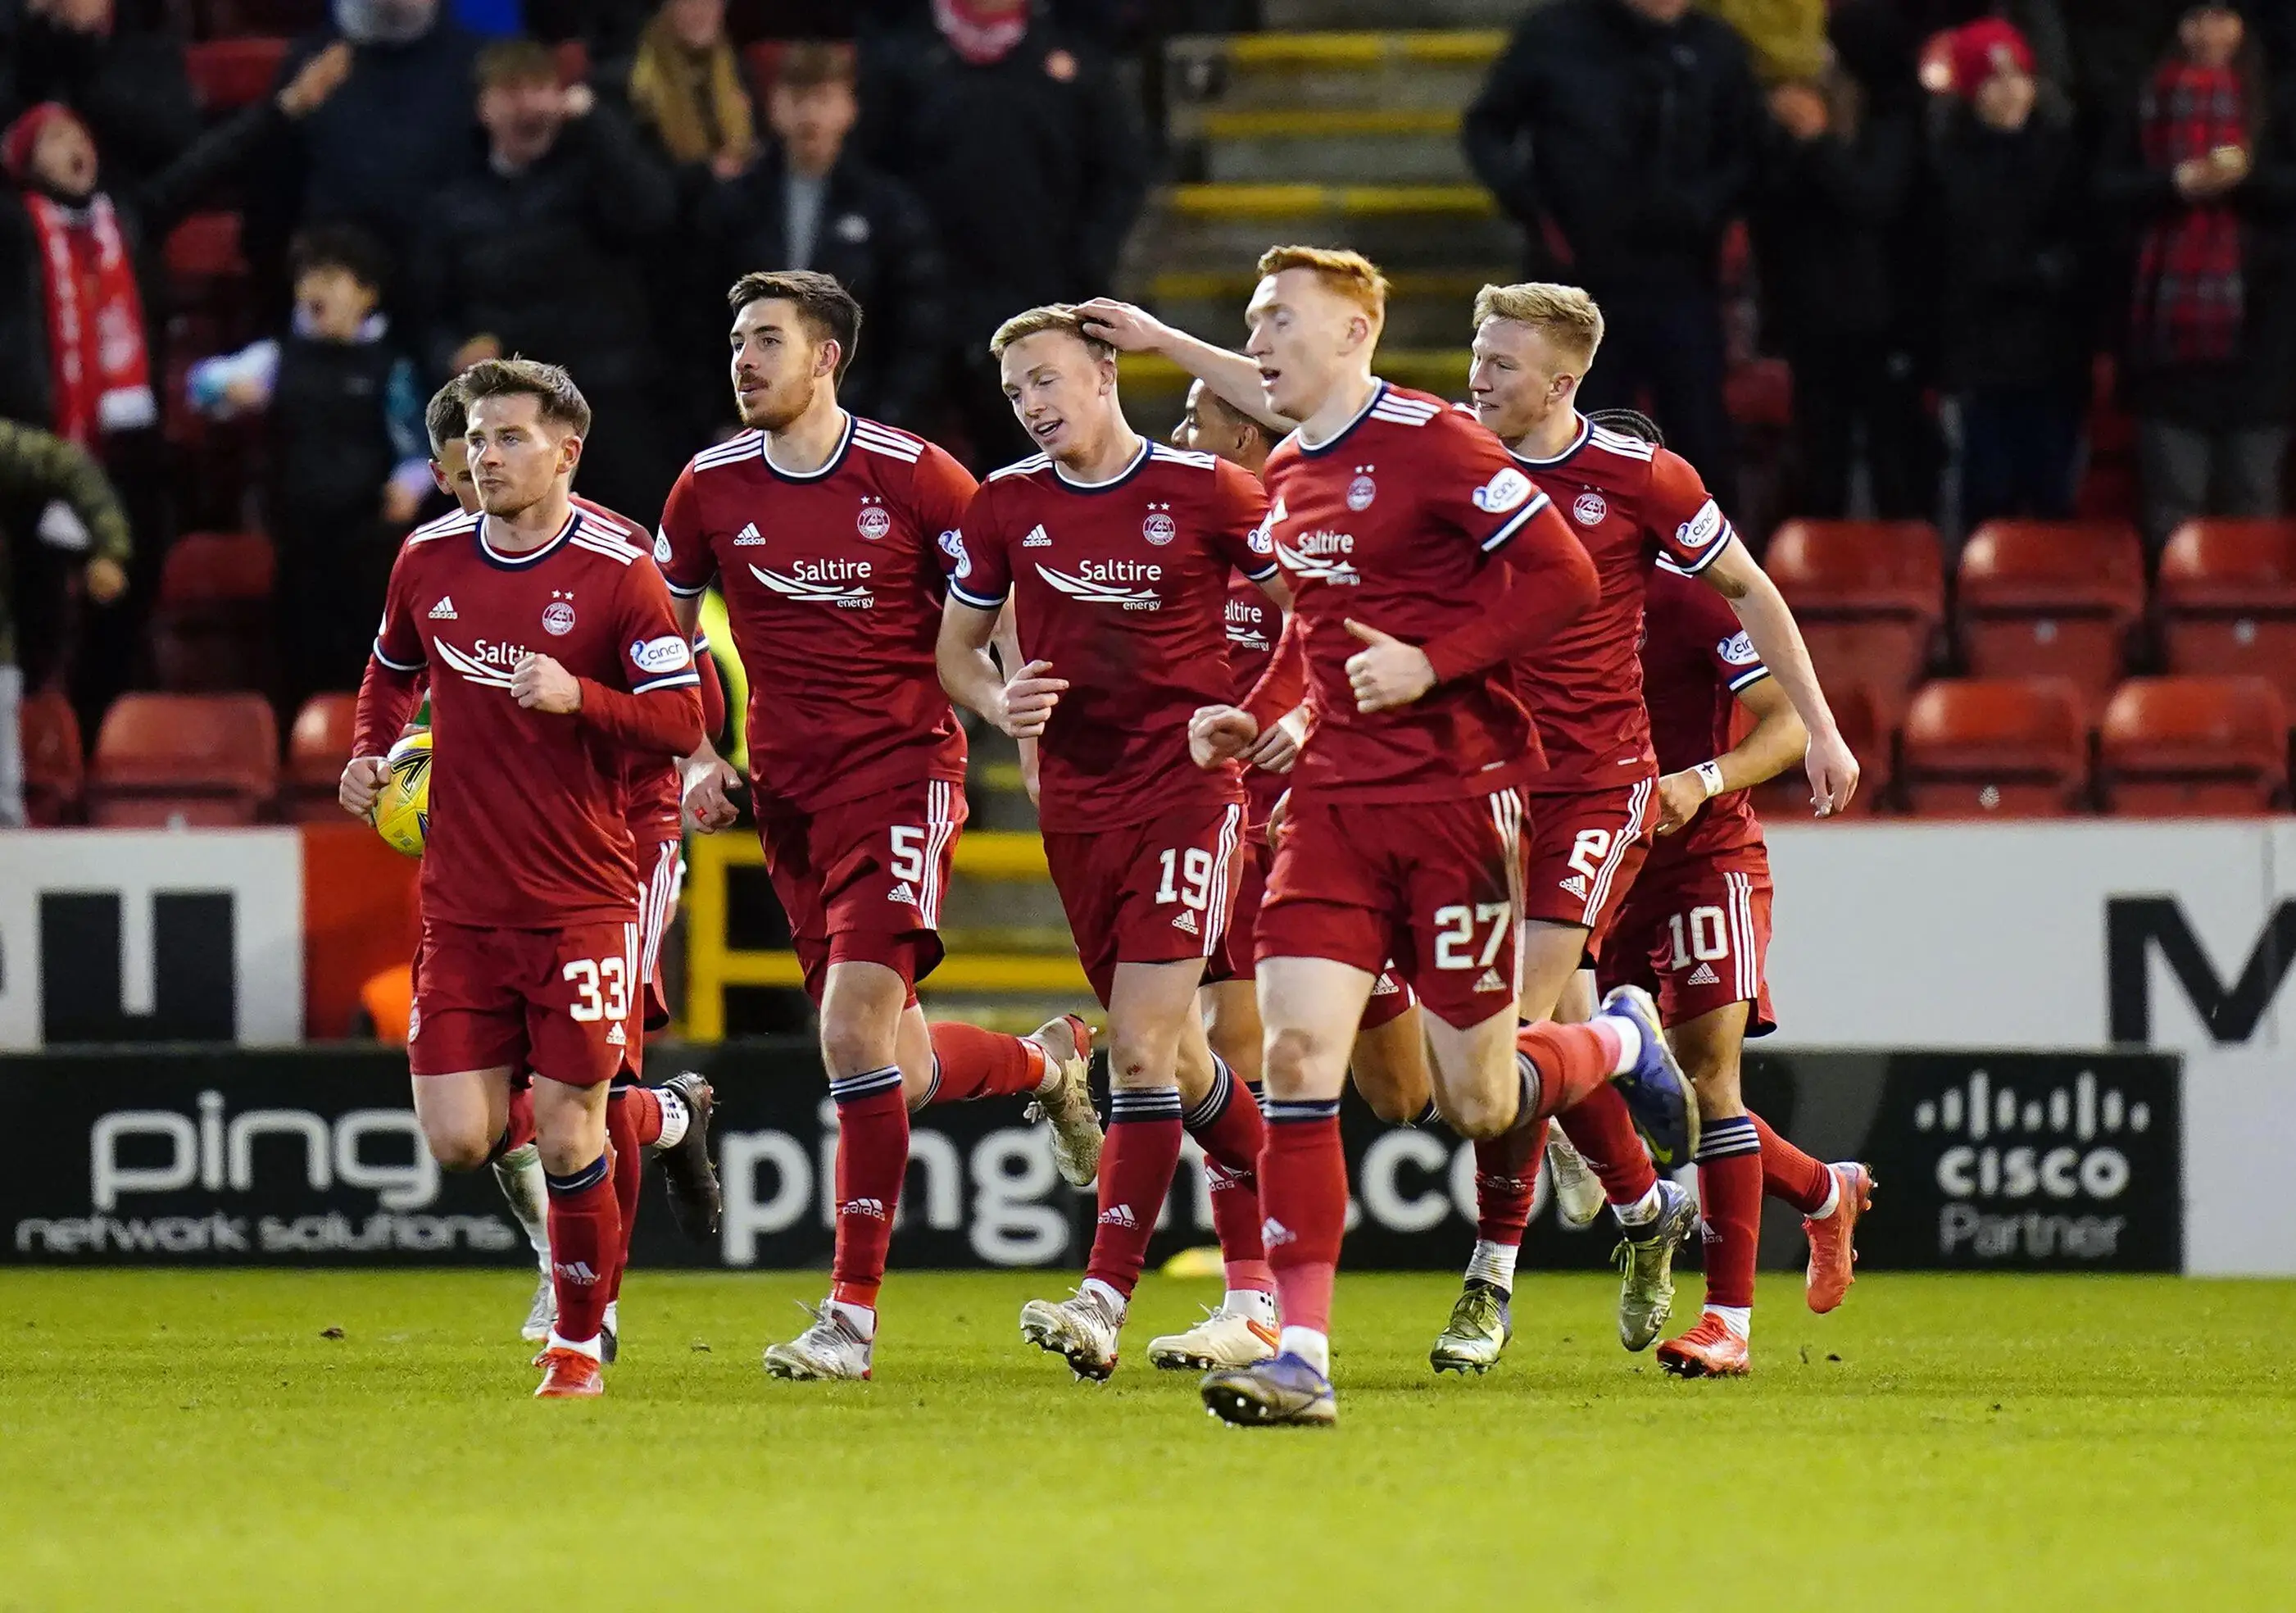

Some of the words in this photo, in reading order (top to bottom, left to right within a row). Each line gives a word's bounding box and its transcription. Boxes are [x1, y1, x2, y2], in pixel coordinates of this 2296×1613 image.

[733, 537, 766, 546] adidas
[1023, 538, 1052, 547] adidas
[1297, 529, 1354, 555] Saltire
[792, 560, 872, 582] Saltire
[1080, 560, 1162, 582] Saltire
[837, 597, 874, 610] energy
[1123, 599, 1162, 611] energy
[1224, 599, 1262, 623] altire
[474, 639, 536, 666] Salti
[890, 825, 925, 883] 5
[1568, 828, 1610, 880] 2
[1155, 847, 1214, 911] 19
[1559, 879, 1587, 902] adidas
[1435, 902, 1511, 970] 27
[1668, 905, 1729, 971] 10
[562, 956, 627, 1021] 33
[1687, 976, 1720, 985] adidas
[91, 1088, 441, 1211] ping
[16, 1211, 247, 1252] network
[259, 1211, 518, 1252] solutions
